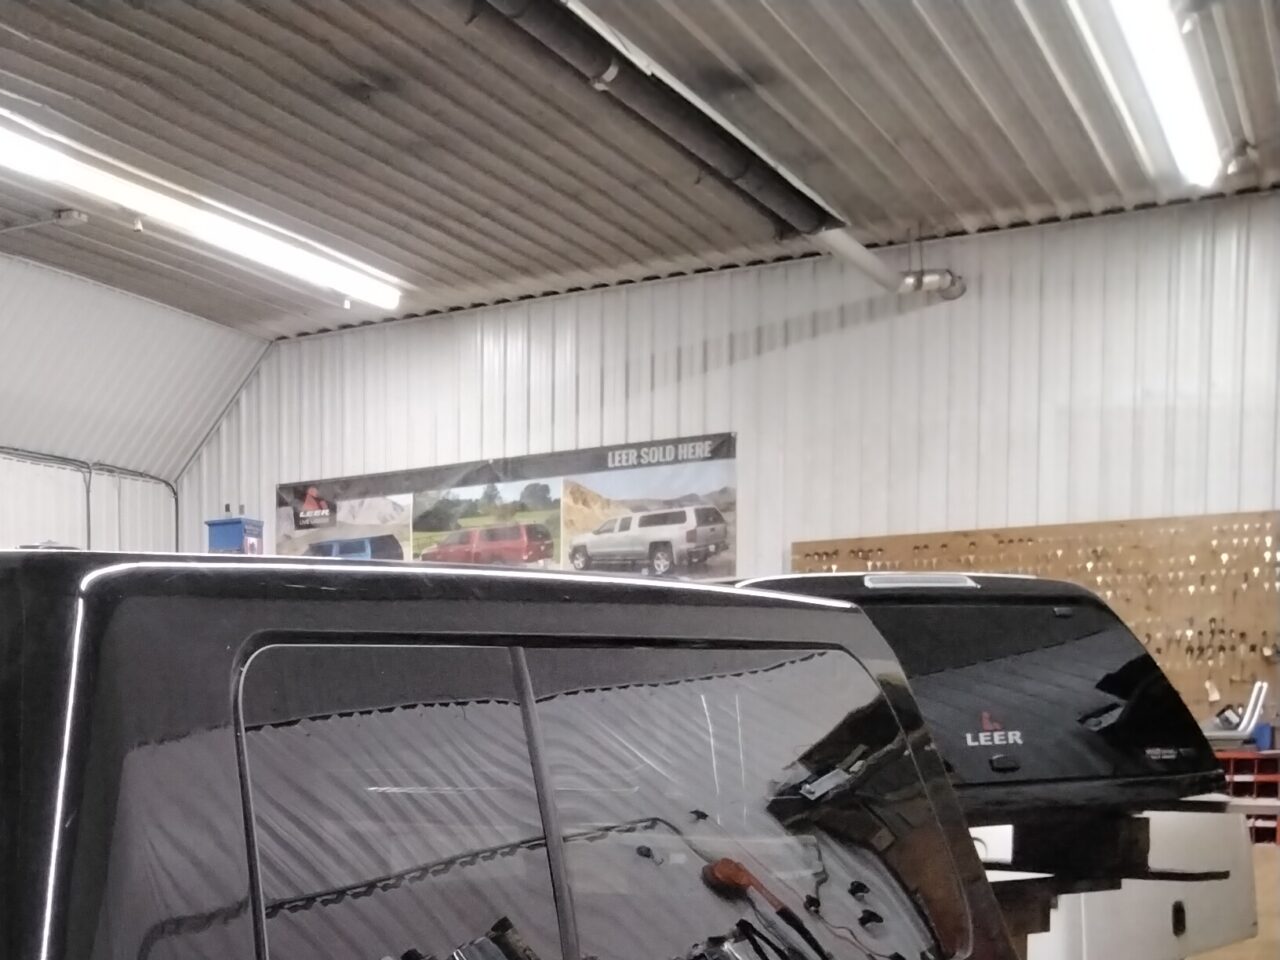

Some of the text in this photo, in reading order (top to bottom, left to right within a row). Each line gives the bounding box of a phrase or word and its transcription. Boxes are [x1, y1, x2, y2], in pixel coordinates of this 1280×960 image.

[607, 440, 713, 468] LEER SOLD HERE
[299, 508, 330, 518] LEER
[966, 730, 1024, 746] LEER
